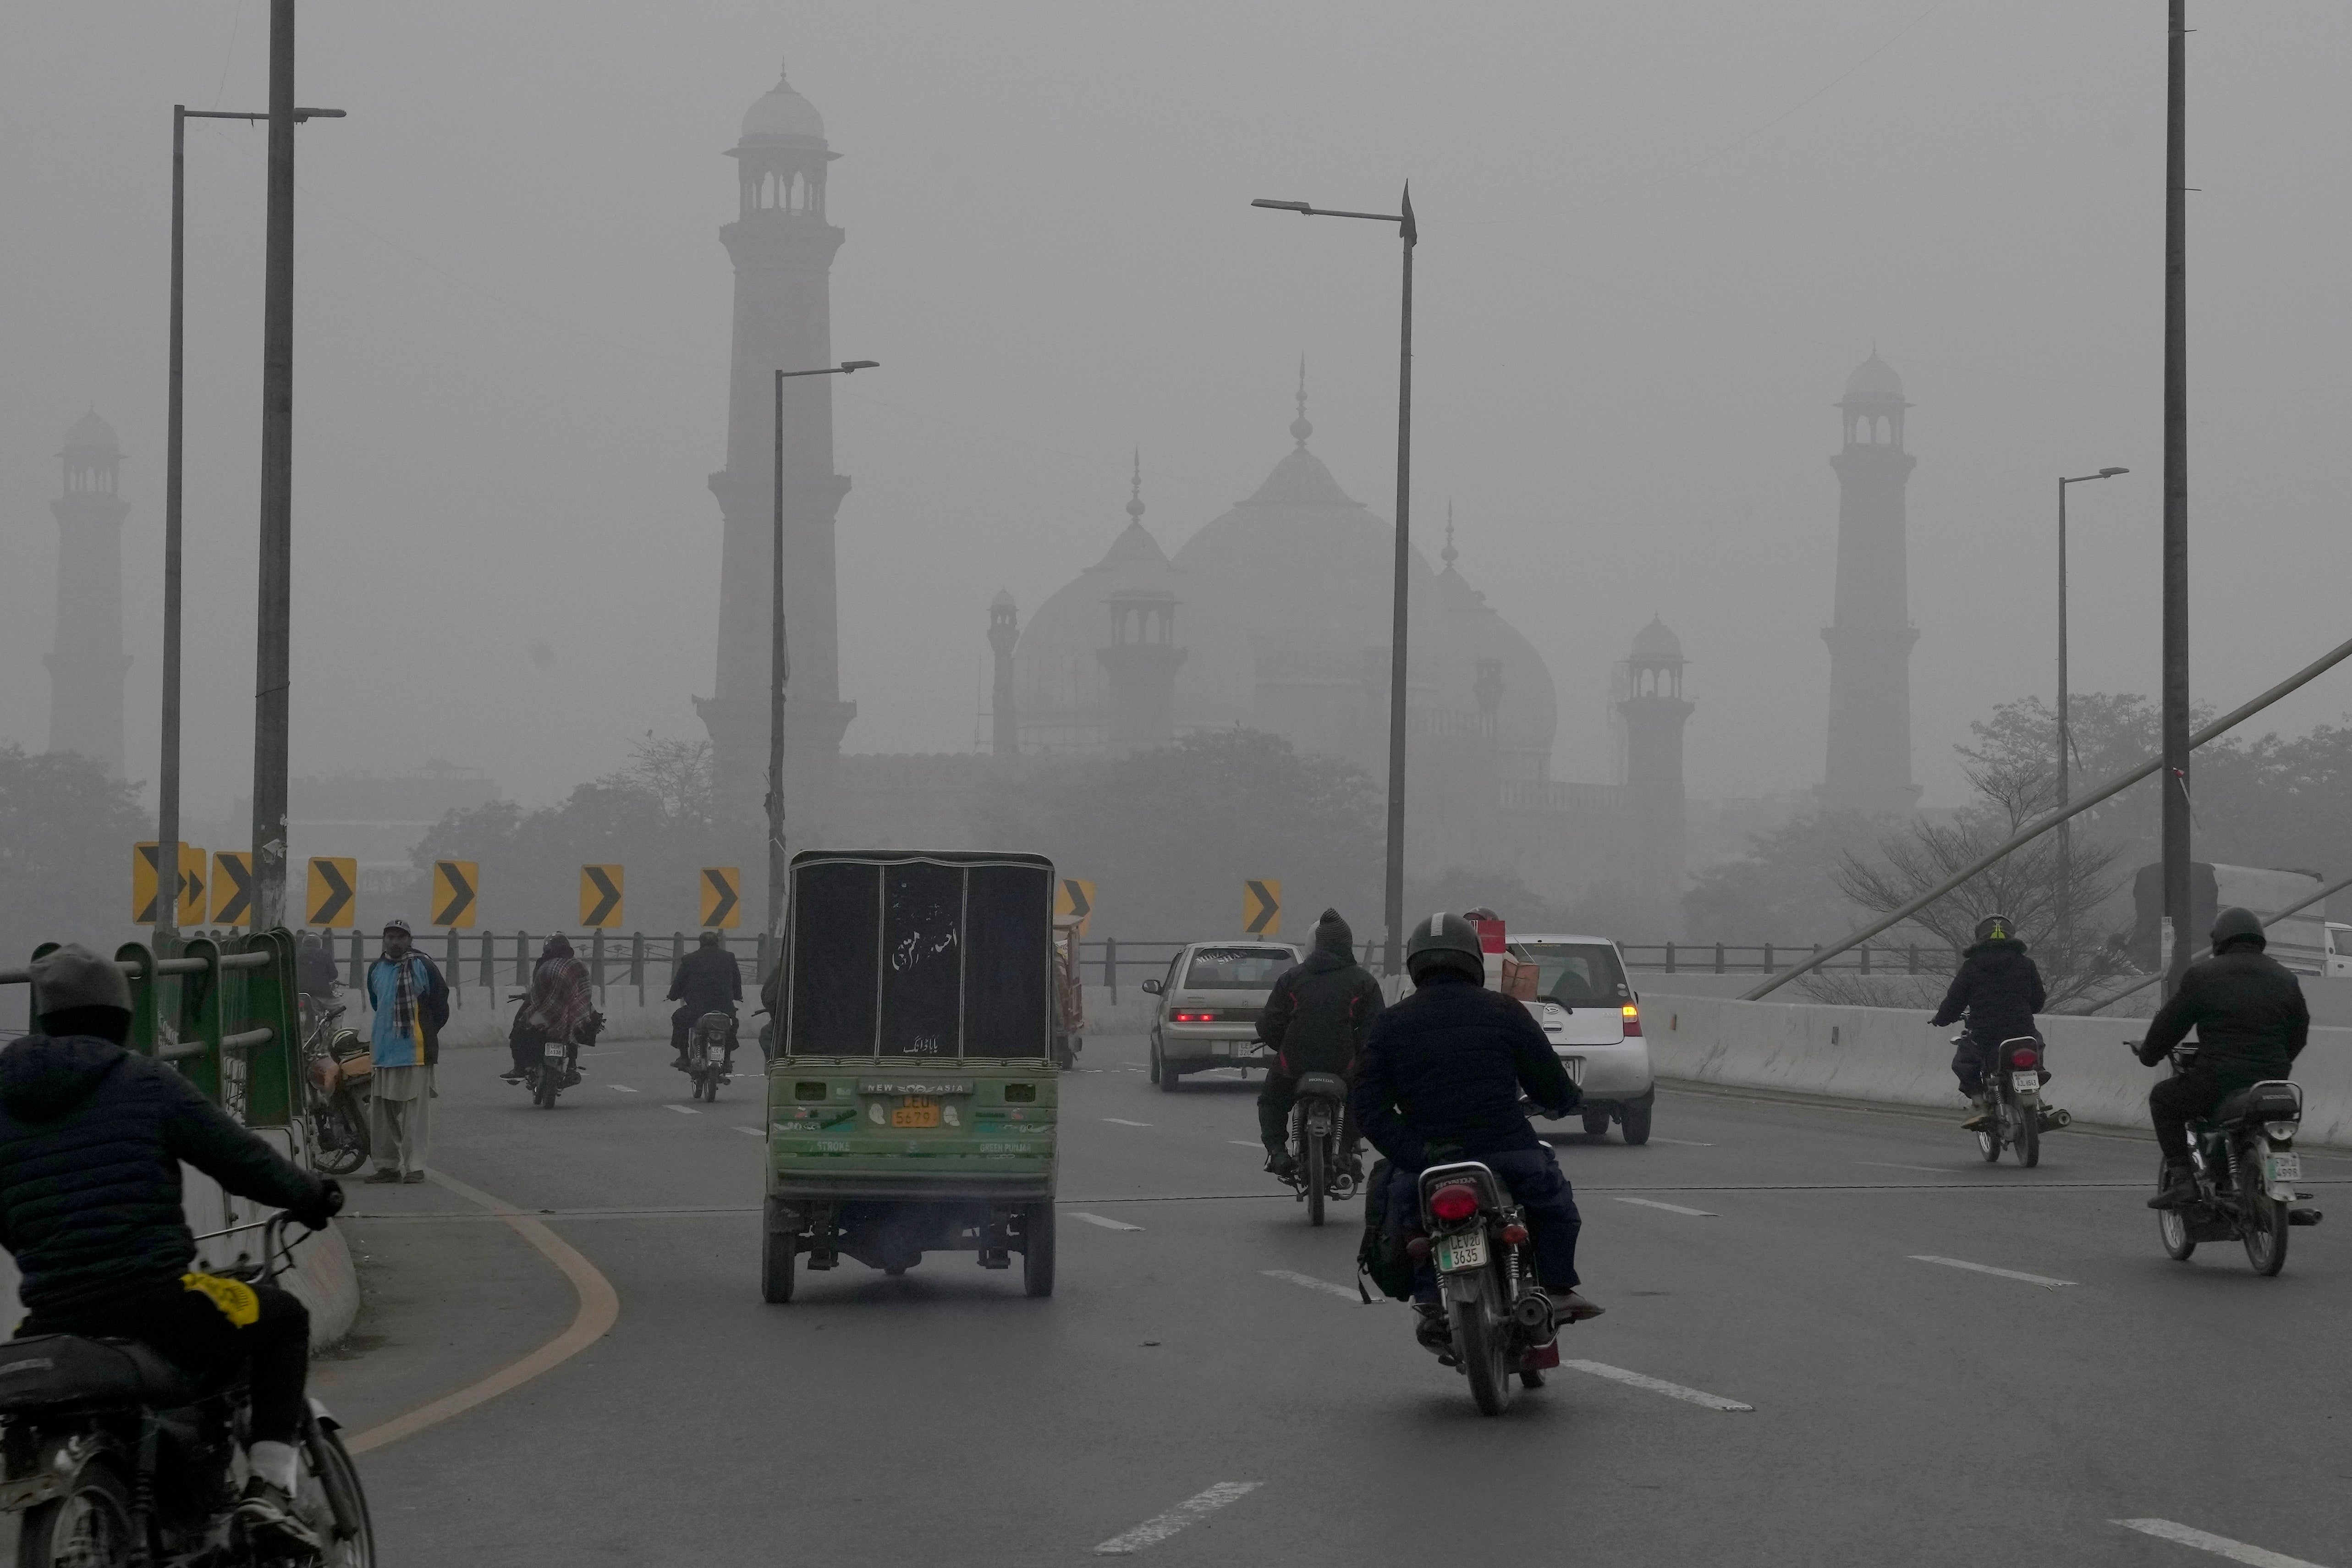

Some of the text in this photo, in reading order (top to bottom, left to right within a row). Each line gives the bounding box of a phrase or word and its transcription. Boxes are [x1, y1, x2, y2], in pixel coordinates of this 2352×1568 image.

[896, 1111, 930, 1124] 5679
[817, 1141, 851, 1152] STROKE
[980, 1144, 1003, 1153] GREEN
[1434, 1177, 1477, 1190] HONDA
[1452, 1249, 1478, 1265] 3635
